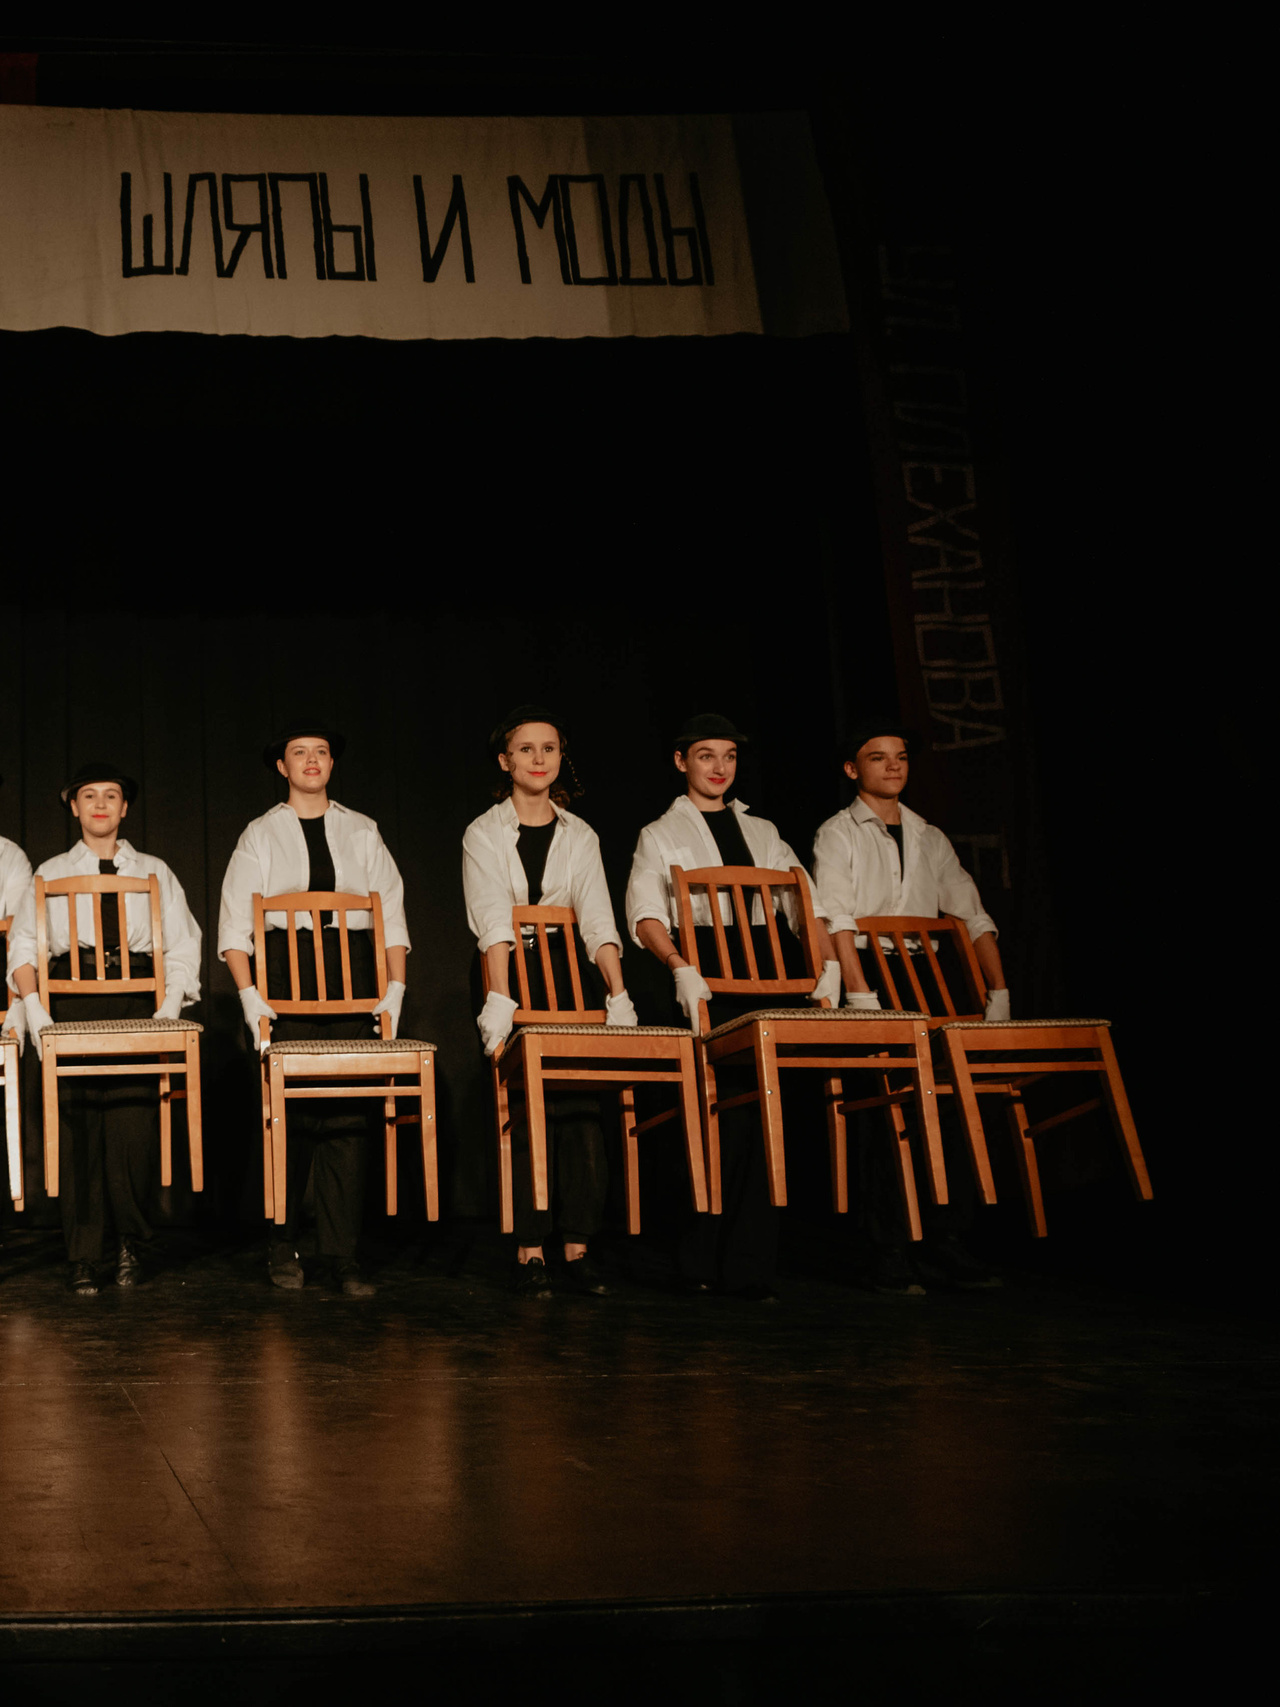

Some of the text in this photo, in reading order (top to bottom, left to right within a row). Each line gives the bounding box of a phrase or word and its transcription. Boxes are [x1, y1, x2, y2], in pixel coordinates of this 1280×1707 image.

[120, 172, 715, 286] ШЛЯПЫ И МОДЫ
[889, 363, 1007, 751] ПЛЕХАНОВА
